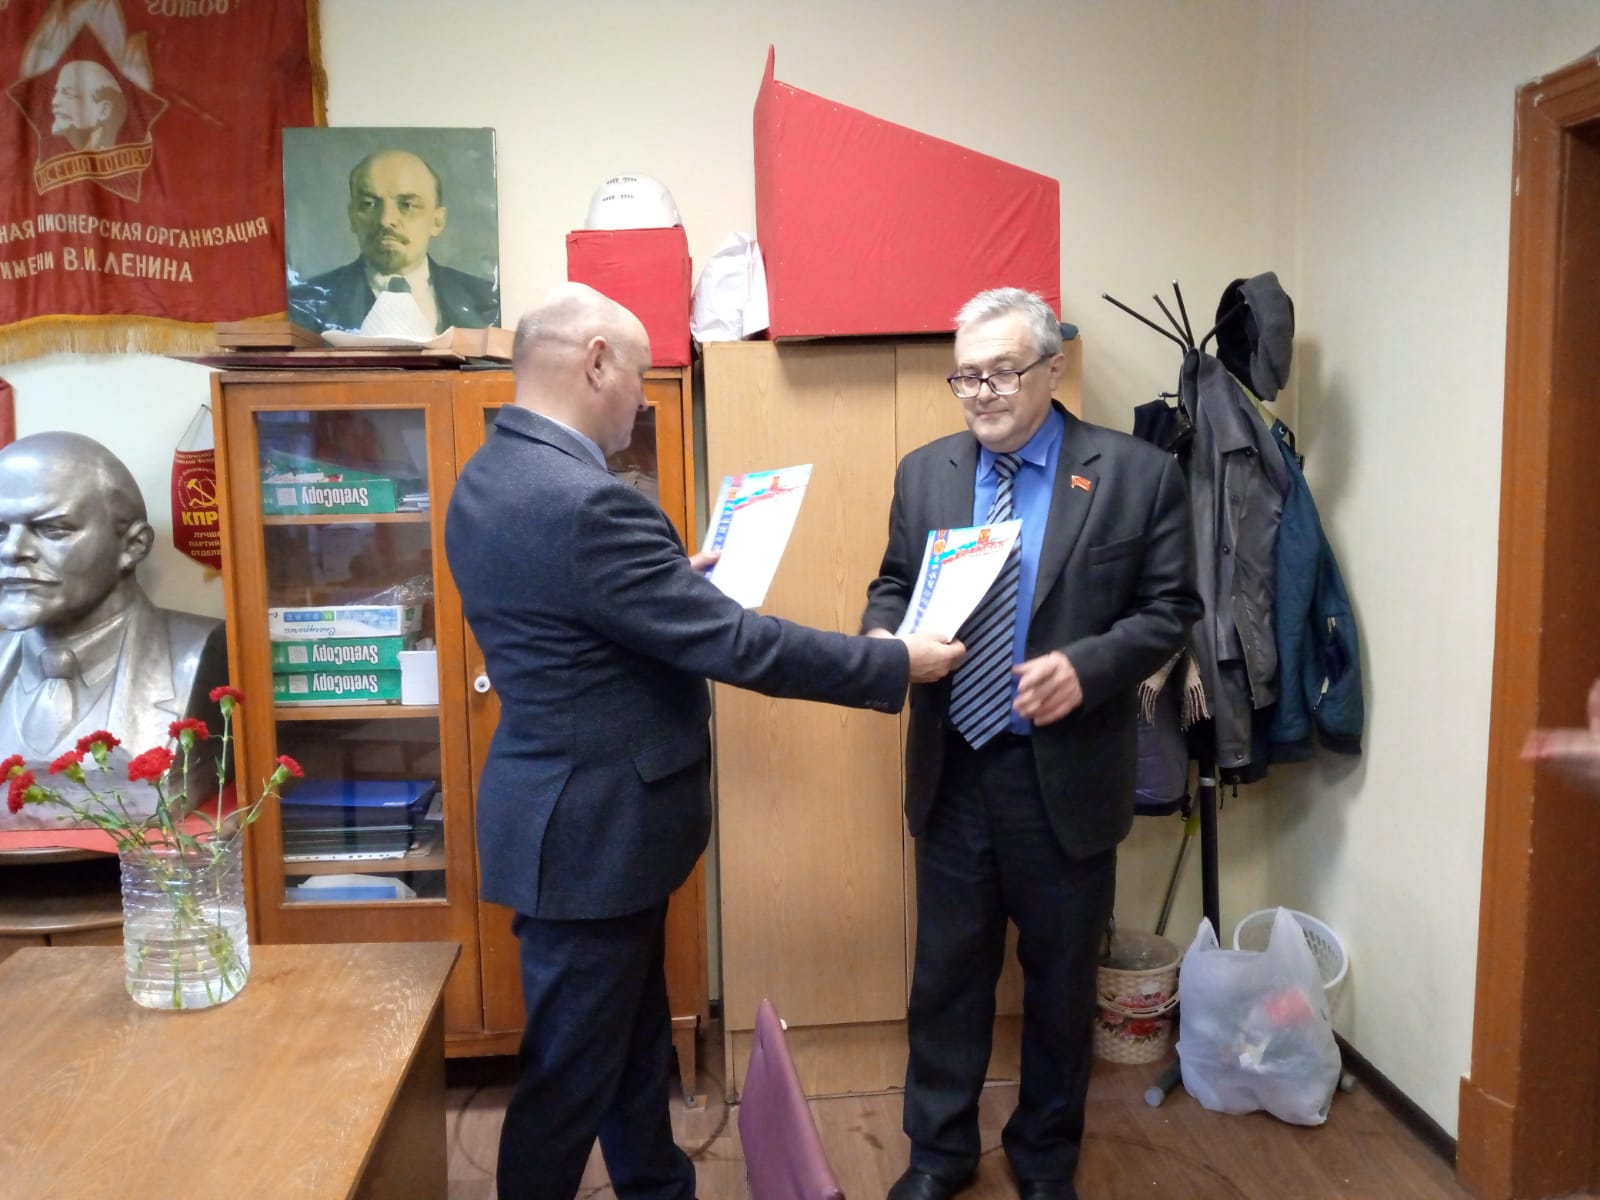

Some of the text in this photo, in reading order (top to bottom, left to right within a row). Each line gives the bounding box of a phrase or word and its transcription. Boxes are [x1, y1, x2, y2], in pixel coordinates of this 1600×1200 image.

[38, 213, 141, 241] ПИОНЕРСКАЯ
[146, 217, 268, 248] ОРГАНИЗАЦИЯ
[1, 251, 54, 280] ИМЕНИ
[302, 486, 368, 507] SvetoCopy
[312, 645, 378, 665] SvetoCopy
[312, 673, 378, 695] SvetoCopy
